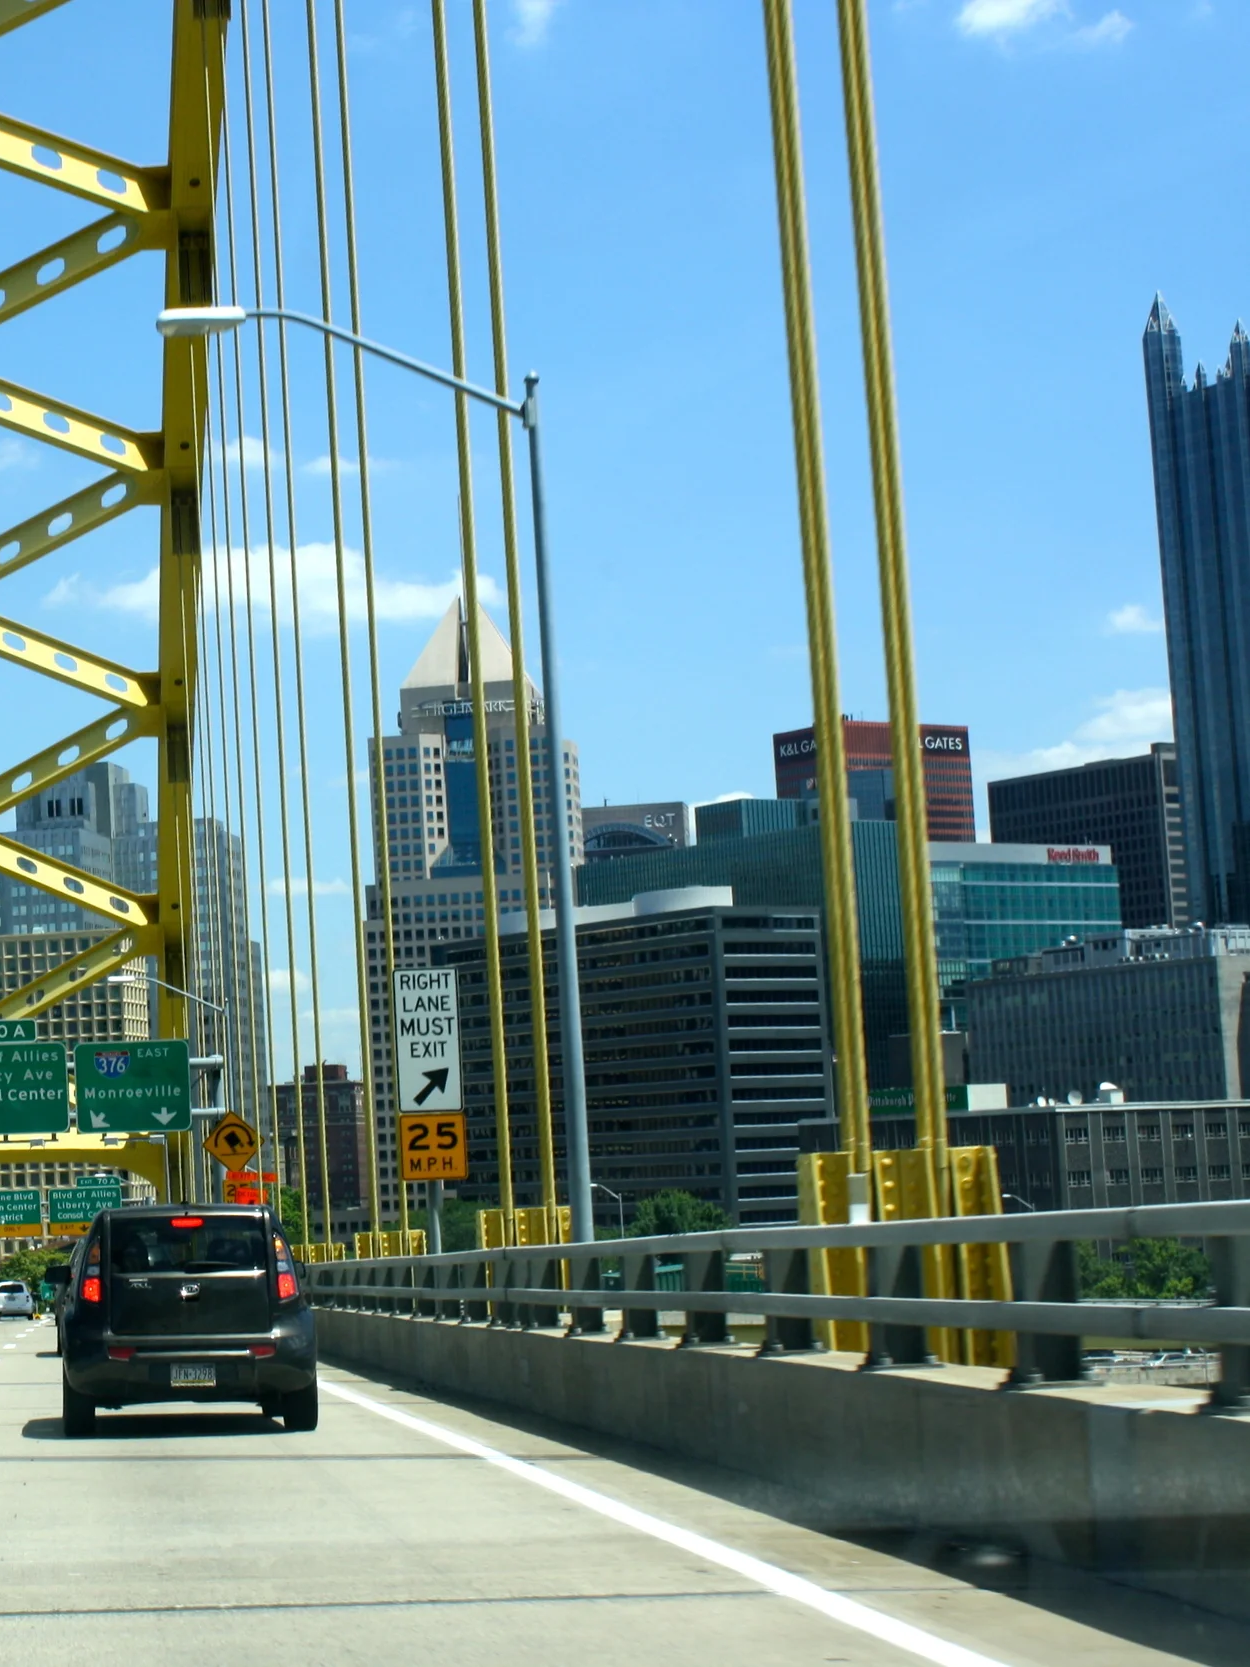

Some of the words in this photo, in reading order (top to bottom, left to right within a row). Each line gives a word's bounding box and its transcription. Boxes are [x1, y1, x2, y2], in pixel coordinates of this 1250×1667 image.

[780, 742, 799, 757] K&L
[925, 736, 962, 750] GATES
[645, 813, 676, 828] EQT
[400, 973, 451, 990] RIGHT
[403, 996, 451, 1012] LANE
[400, 1017, 455, 1036] MUST
[12, 1050, 59, 1062] Allies
[137, 1048, 169, 1058] EAST
[411, 1041, 447, 1058] EXIT
[99, 1056, 126, 1073] 376
[24, 1069, 53, 1080] Ave
[8, 1087, 63, 1101] Center
[85, 1085, 181, 1099] Monroeville
[408, 1122, 458, 1150] 25
[52, 1191, 72, 1199] Blvd
[91, 1190, 117, 1198] Allies
[7, 1203, 37, 1211] Center
[57, 1201, 90, 1210] Liberty
[58, 1211, 83, 1219] Consol
